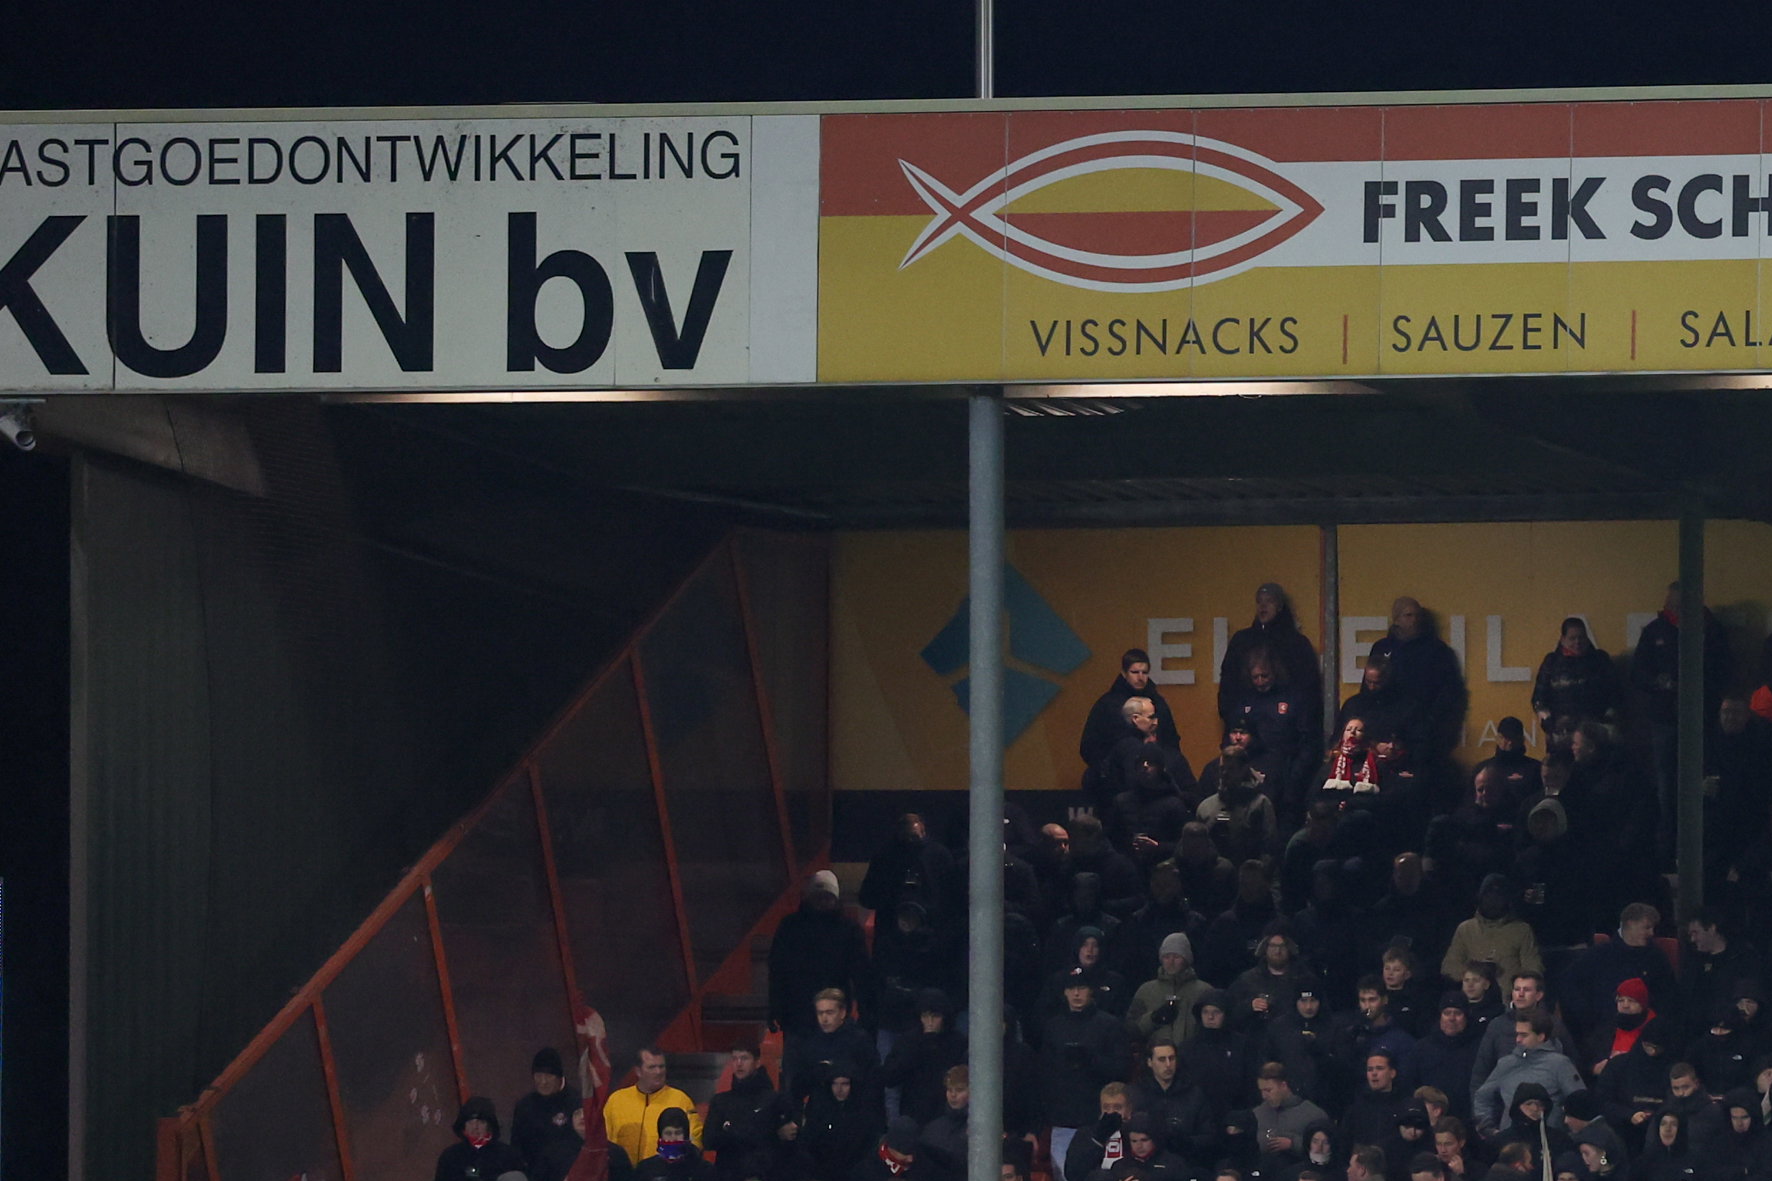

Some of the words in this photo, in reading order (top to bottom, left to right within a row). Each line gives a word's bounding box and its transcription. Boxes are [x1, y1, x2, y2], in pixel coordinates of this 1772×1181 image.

[0, 130, 741, 187] ASTGOEDONTWIKKELING
[1363, 174, 1609, 244] FREEK
[0, 212, 434, 378] KUIN
[506, 212, 733, 374] bv
[1030, 315, 1300, 357] VISSNACKS
[1391, 310, 1588, 353] SAUZEN
